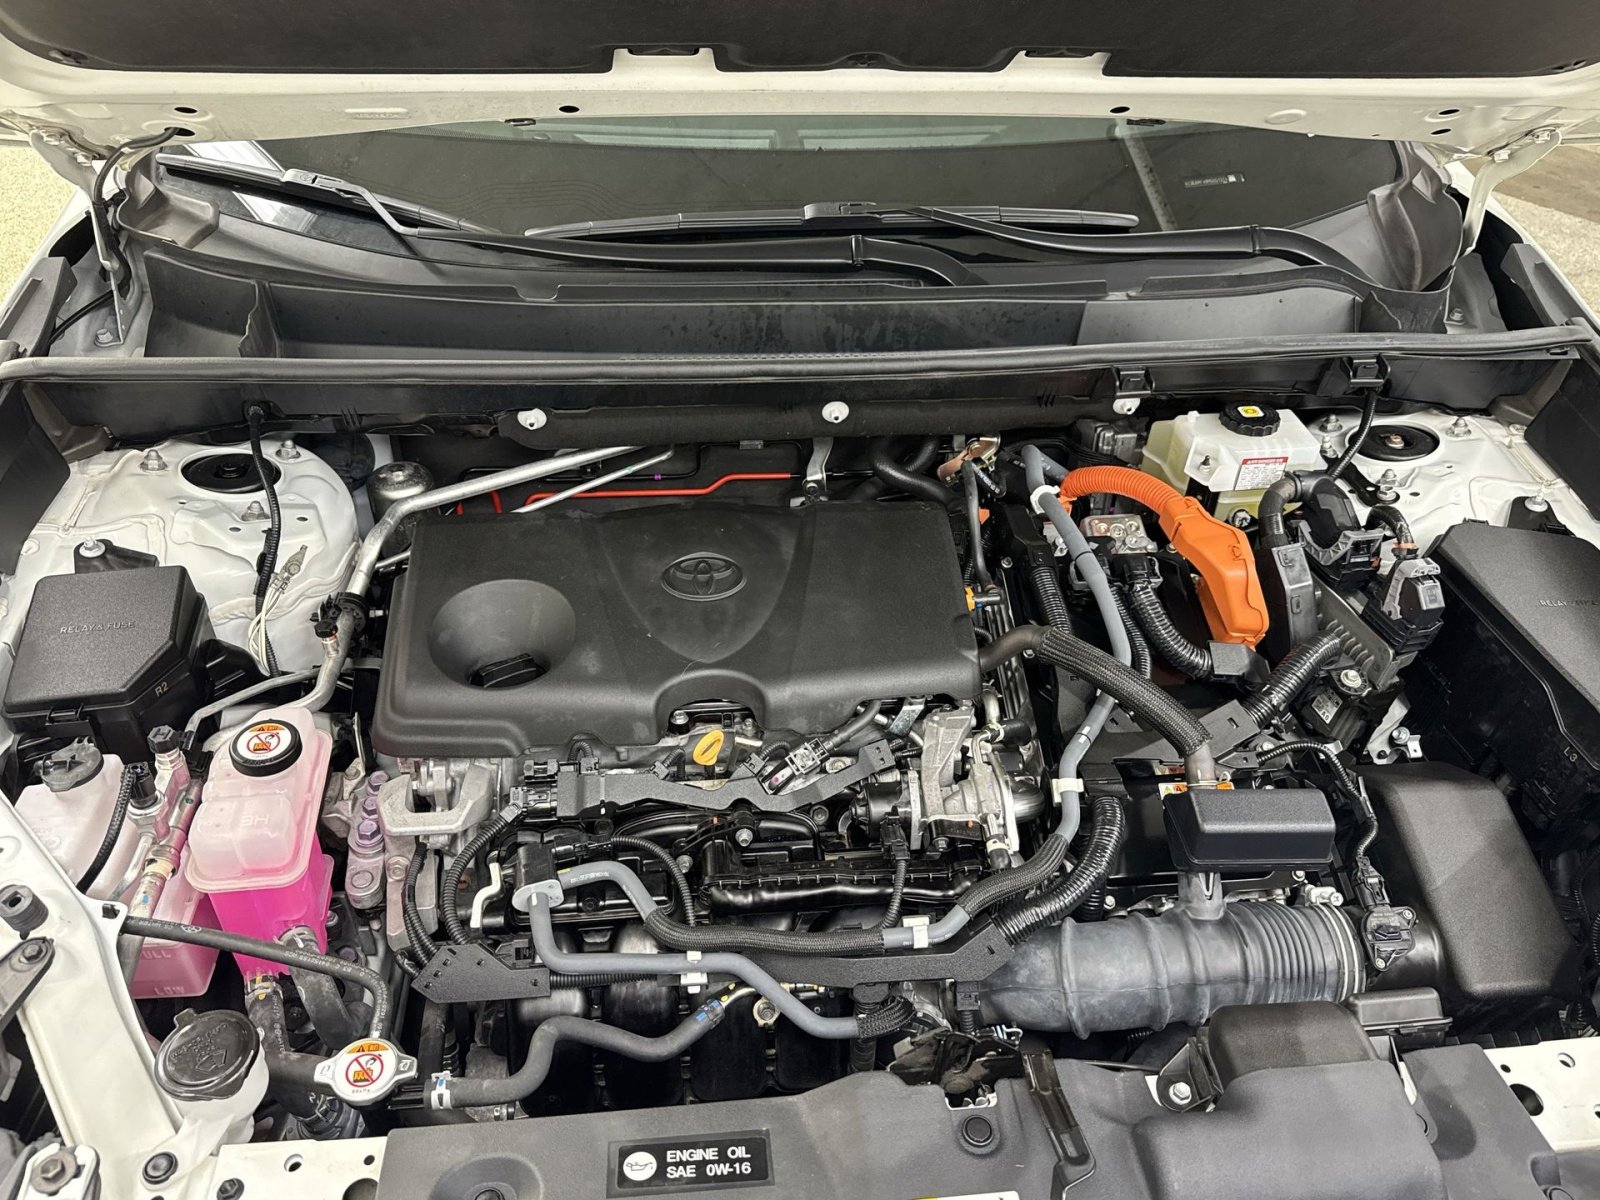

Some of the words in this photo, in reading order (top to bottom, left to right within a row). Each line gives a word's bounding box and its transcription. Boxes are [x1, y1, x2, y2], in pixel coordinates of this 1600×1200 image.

[60, 623, 96, 634] RELAY
[107, 620, 136, 630] FUSE
[155, 681, 169, 696] R2
[1563, 746, 1578, 763] L3
[141, 949, 171, 959] ULL
[154, 985, 185, 995] LOW
[666, 1148, 719, 1162] ENGINE
[727, 1146, 751, 1158] OIL
[666, 1165, 696, 1178] SAE
[706, 1162, 751, 1176] 0W-16
